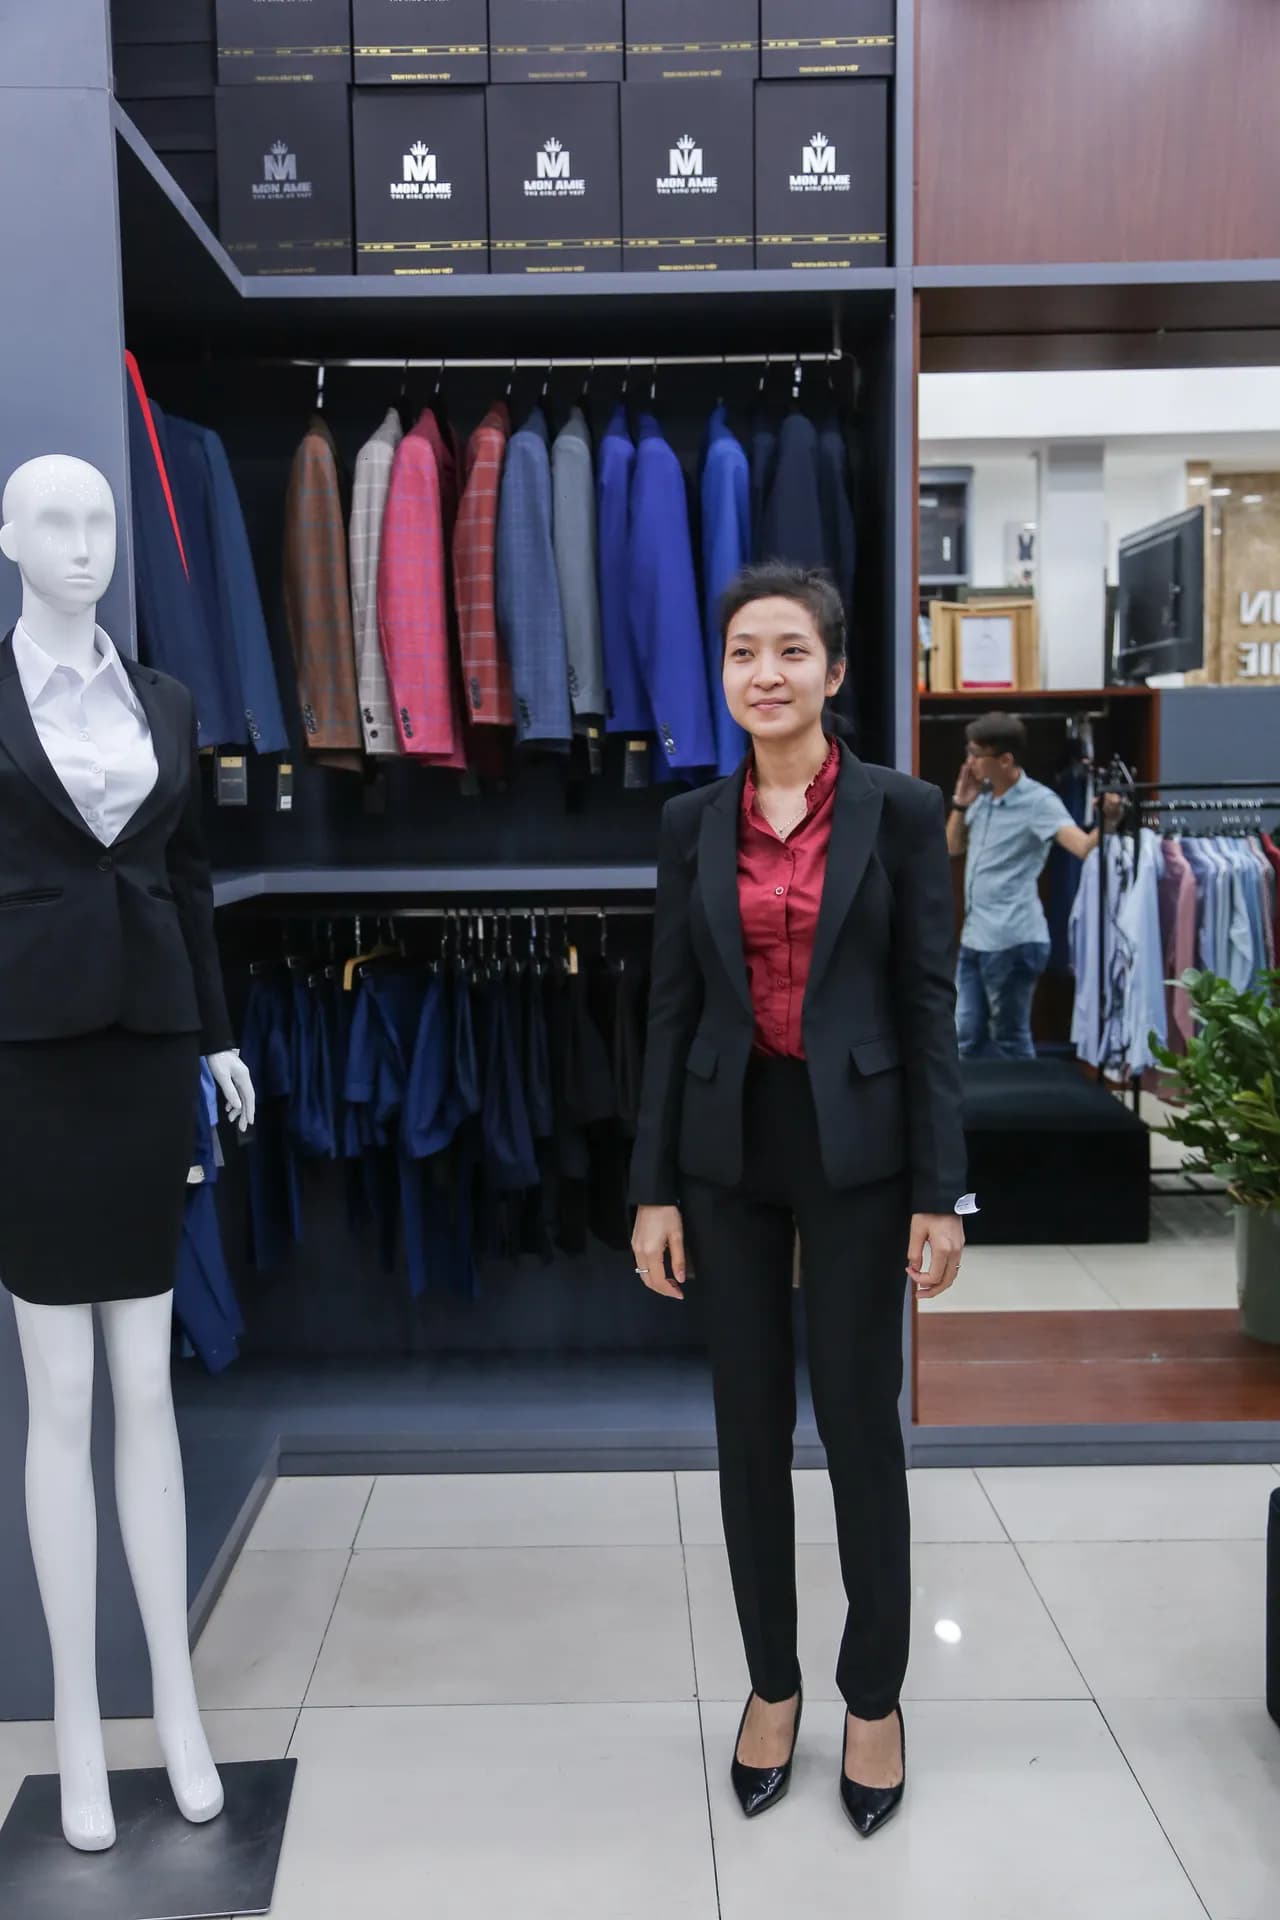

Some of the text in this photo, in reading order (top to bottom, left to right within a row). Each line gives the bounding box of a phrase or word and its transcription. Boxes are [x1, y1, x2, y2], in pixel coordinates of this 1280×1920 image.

[264, 154, 297, 181] M
[403, 155, 436, 181] M
[536, 151, 570, 178] M
[669, 149, 703, 175] M
[802, 146, 836, 173] M
[252, 182, 312, 194] MON AMIE
[390, 182, 451, 193] MON AMIE
[524, 179, 585, 190] MON AMIE
[656, 177, 718, 188] MON AMIE
[789, 175, 850, 185] MON AMIE
